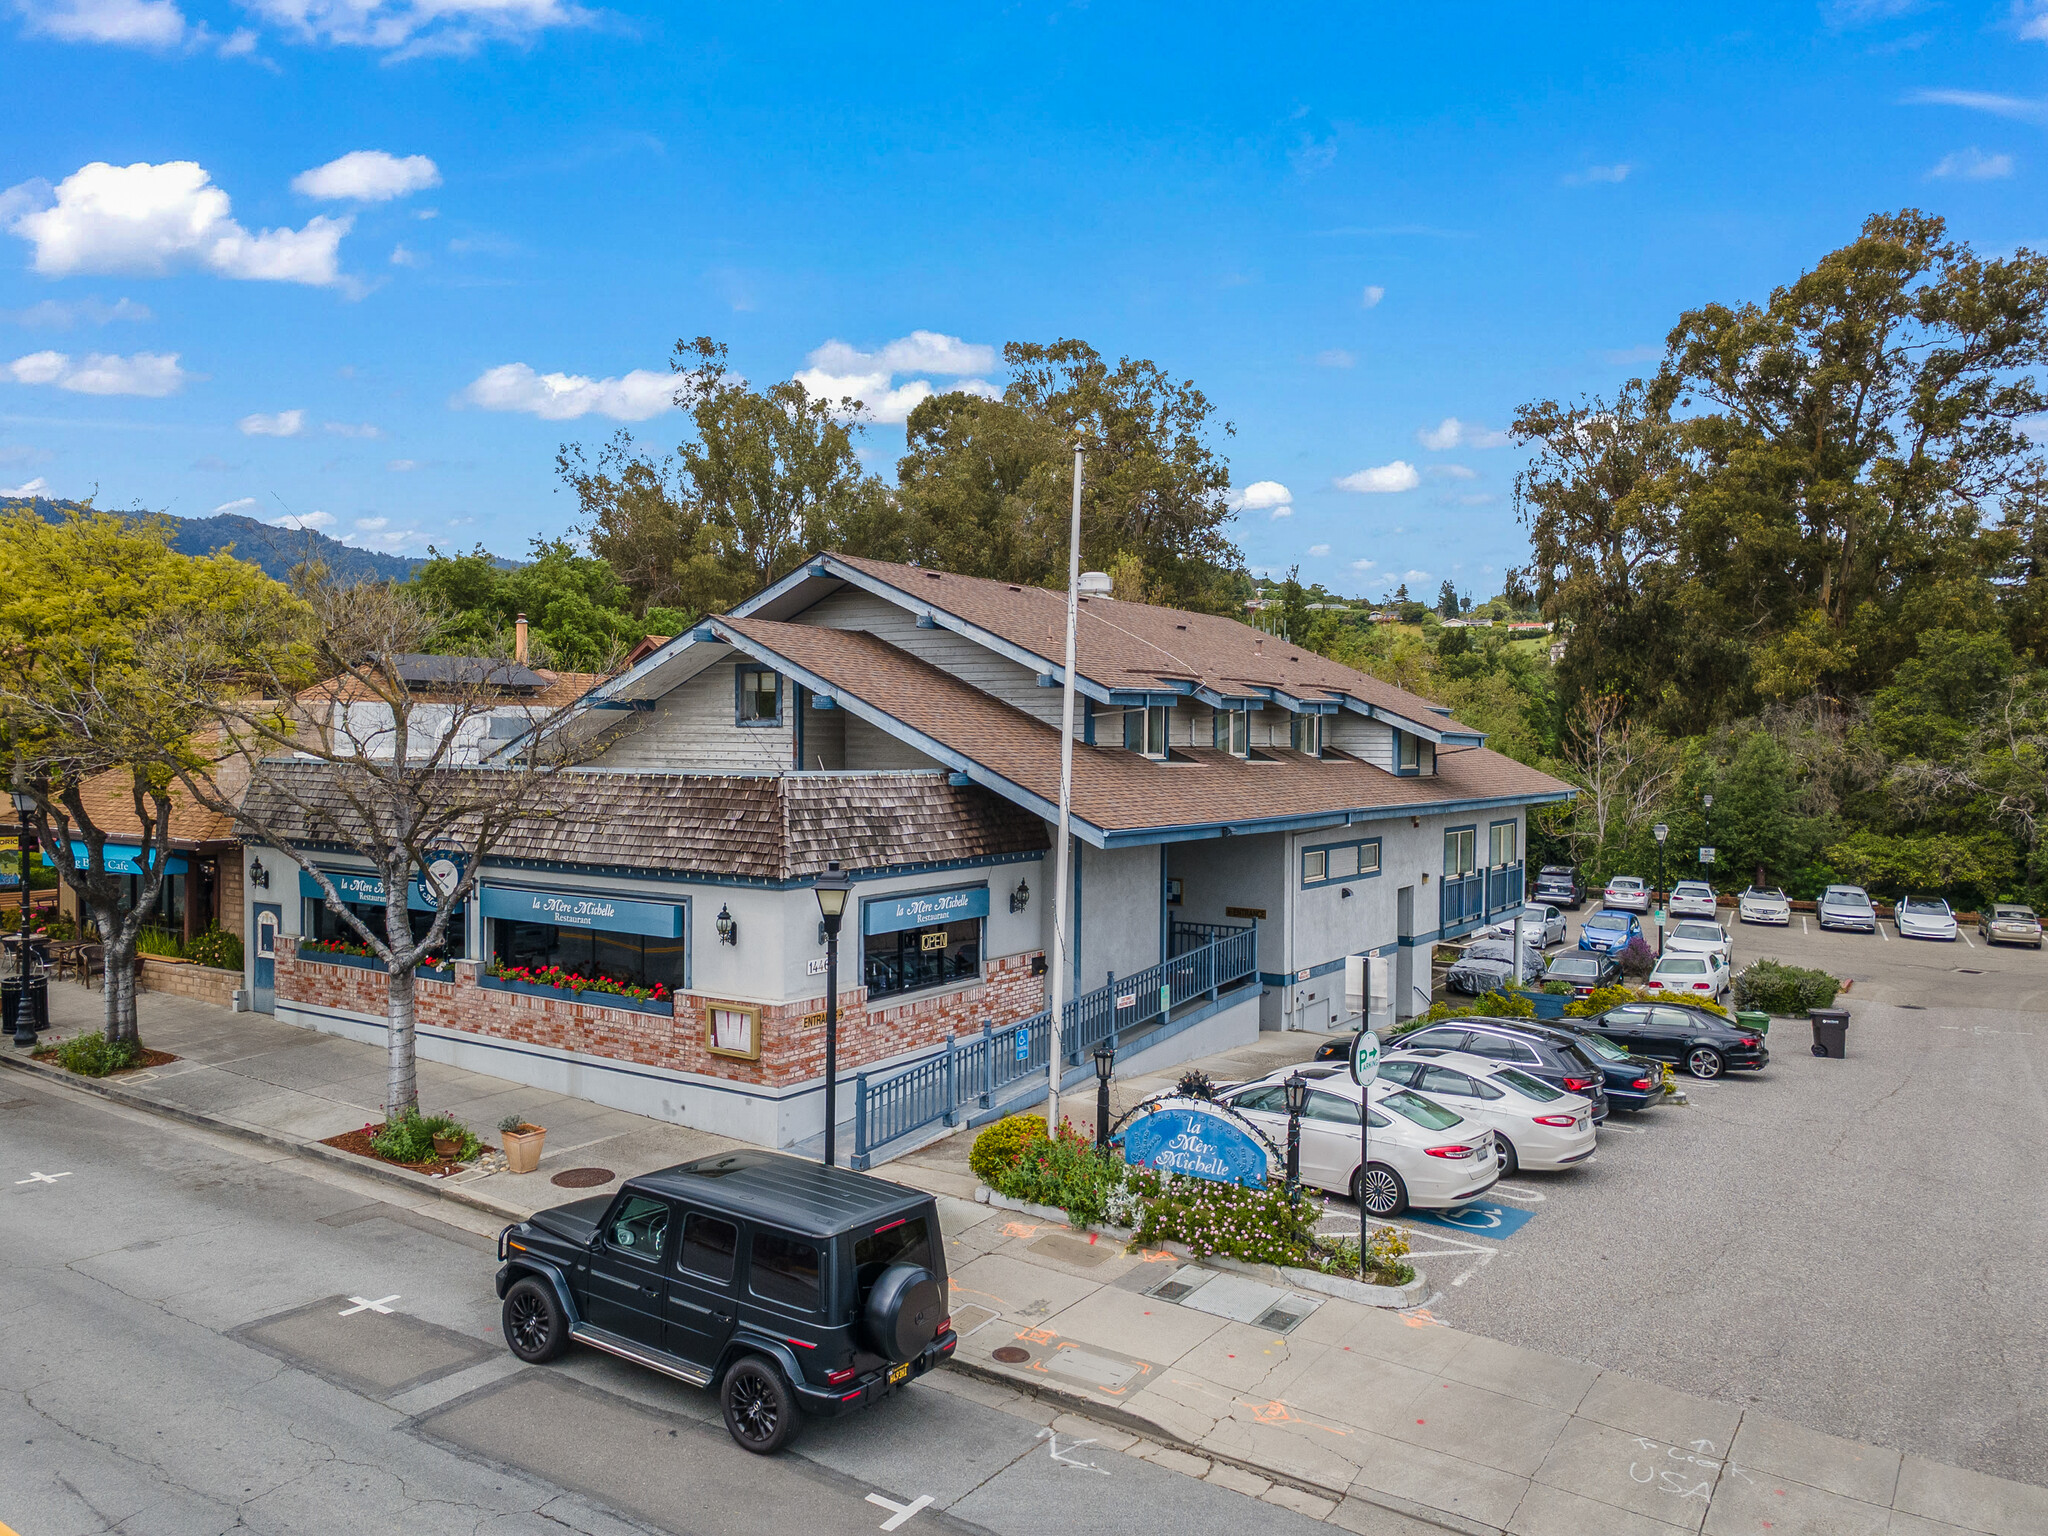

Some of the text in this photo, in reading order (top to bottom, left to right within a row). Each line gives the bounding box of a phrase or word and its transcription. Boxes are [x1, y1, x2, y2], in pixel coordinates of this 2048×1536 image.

[107, 860, 129, 871] Cafe
[341, 878, 348, 890] la
[359, 892, 387, 902] Restauran
[532, 897, 540, 909] la
[574, 901, 615, 917] Michelle
[896, 904, 904, 917] la
[934, 894, 969, 911] Michelle
[554, 912, 592, 924] Restaurant
[917, 911, 950, 923] Restaurant
[923, 934, 946, 949] OPEN
[1186, 1116, 1201, 1134] la
[1156, 1151, 1229, 1176] Michelle
[1630, 1462, 1711, 1503] USA
